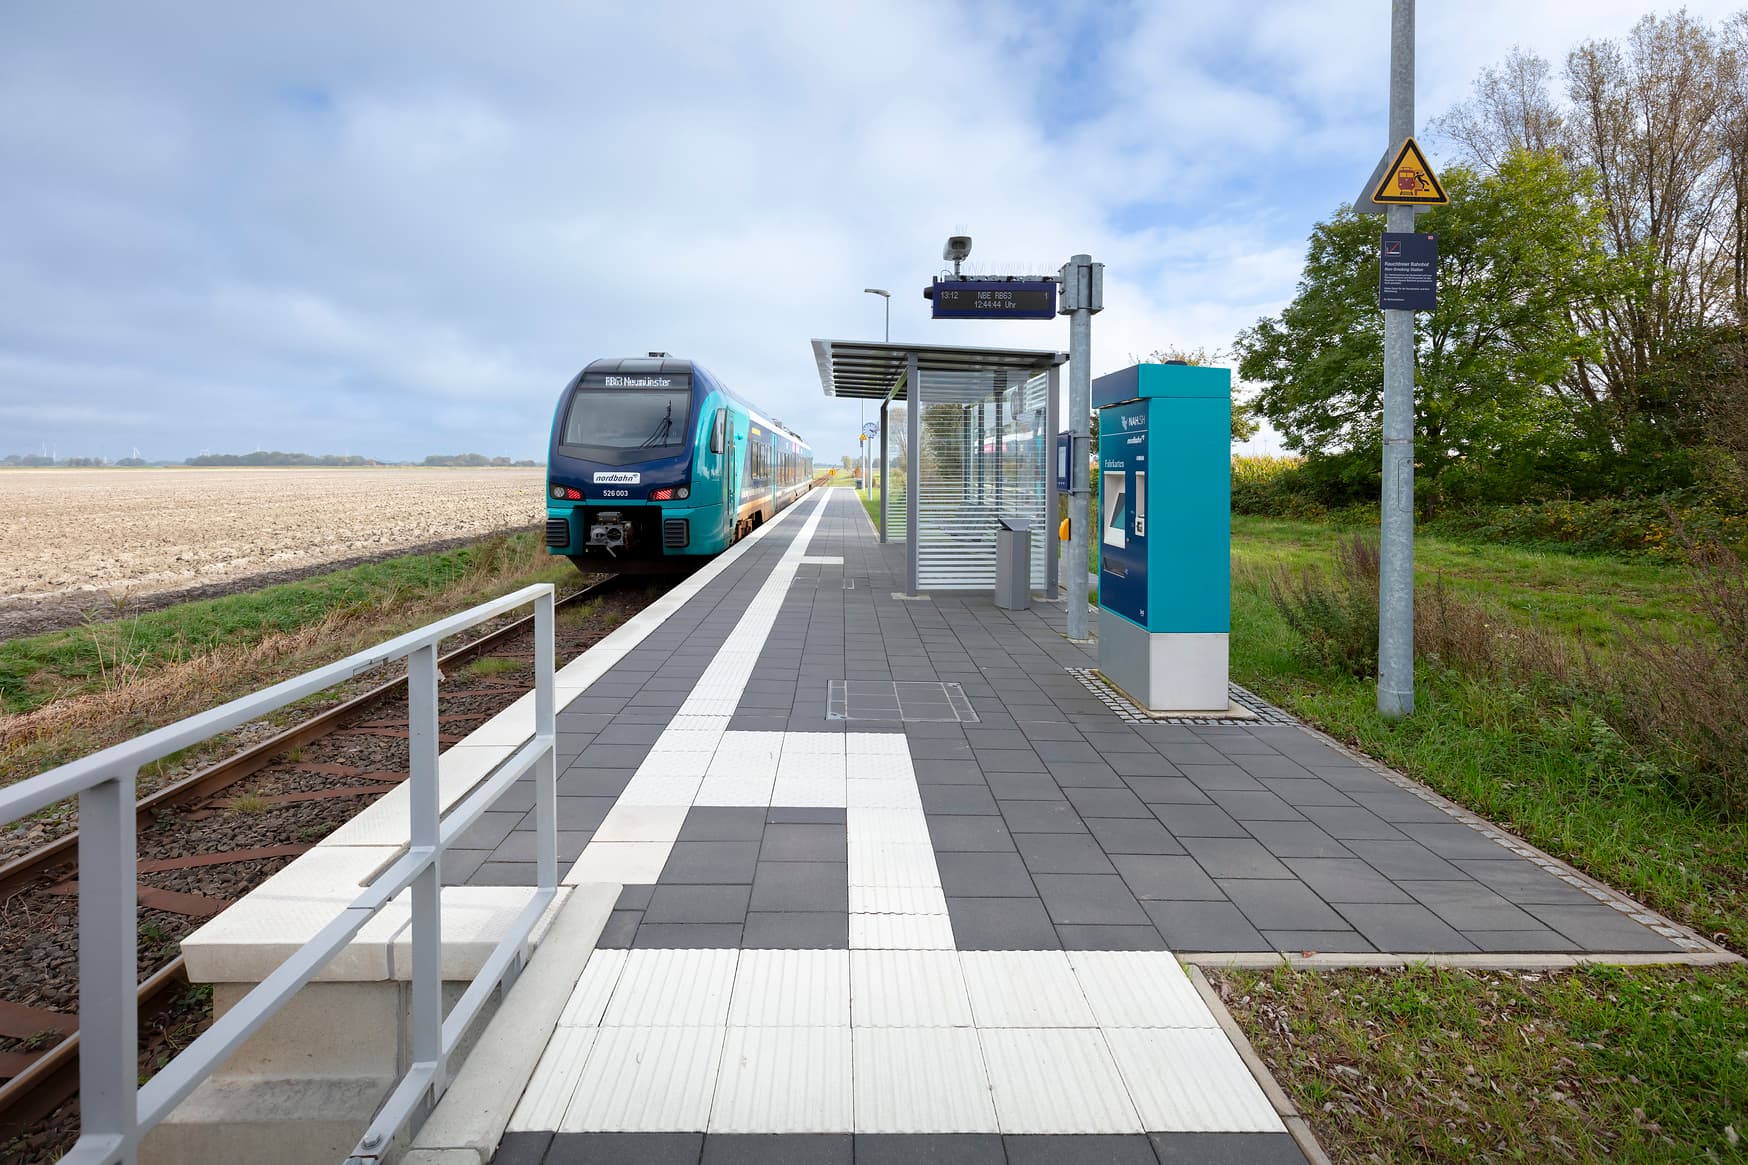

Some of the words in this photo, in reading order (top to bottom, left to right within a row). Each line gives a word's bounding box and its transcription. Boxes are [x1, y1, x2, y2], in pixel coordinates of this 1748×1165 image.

[941, 291, 959, 299] 13:12
[977, 291, 992, 299] NBE
[994, 291, 1012, 299] RB63
[974, 301, 1001, 309] 12:44:44
[1004, 301, 1017, 309] Uhr
[605, 376, 623, 386] RB63
[623, 376, 671, 387] Neumünster
[596, 474, 633, 482] nordbahn
